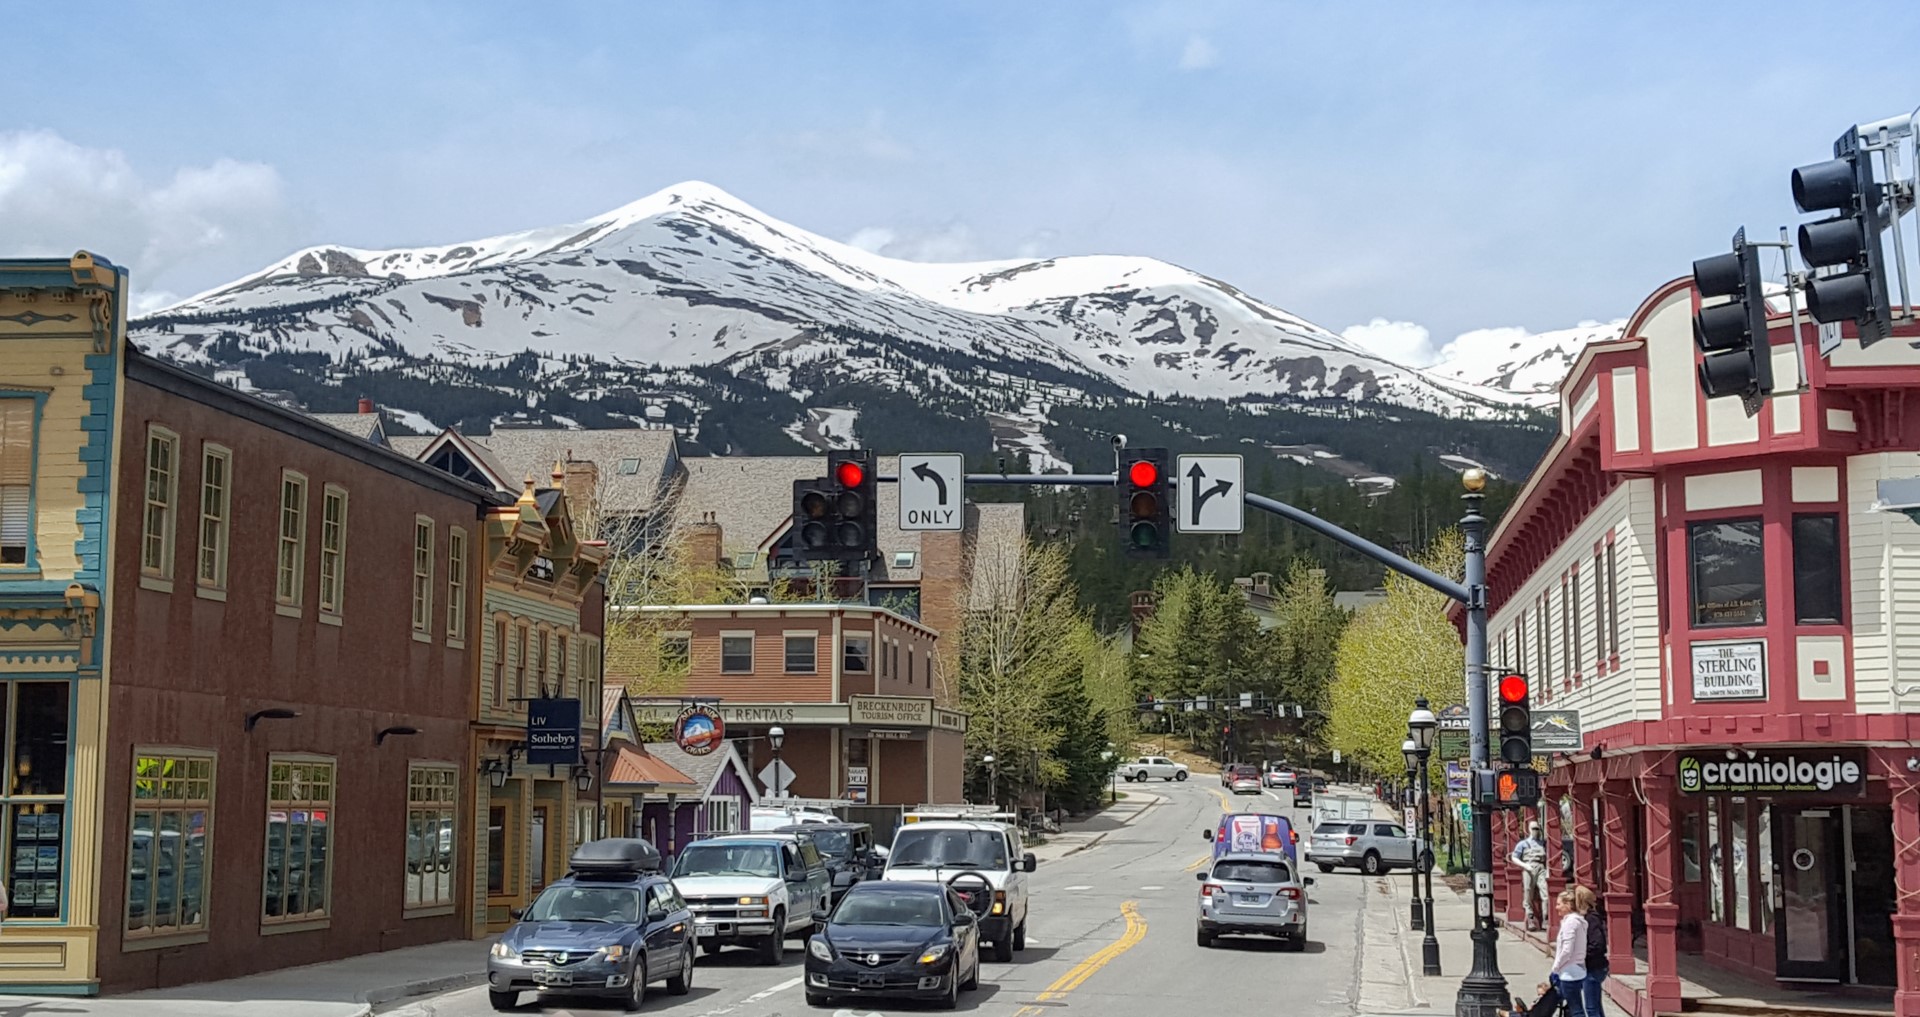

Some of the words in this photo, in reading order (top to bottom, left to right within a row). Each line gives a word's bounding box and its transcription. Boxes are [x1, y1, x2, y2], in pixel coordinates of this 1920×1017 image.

[908, 510, 953, 524] ONLY
[1719, 648, 1734, 658] THE
[1698, 658, 1756, 673] STERLING
[1704, 675, 1753, 688] BUILDING
[857, 701, 926, 713] BRECKENRIDGE
[735, 708, 794, 720] RENTALS
[861, 711, 894, 720] TOURISM
[896, 713, 922, 721] OFFICE
[531, 716, 546, 725] LIV
[531, 733, 576, 745] Sotheby's
[1703, 756, 1859, 790] craniologie
